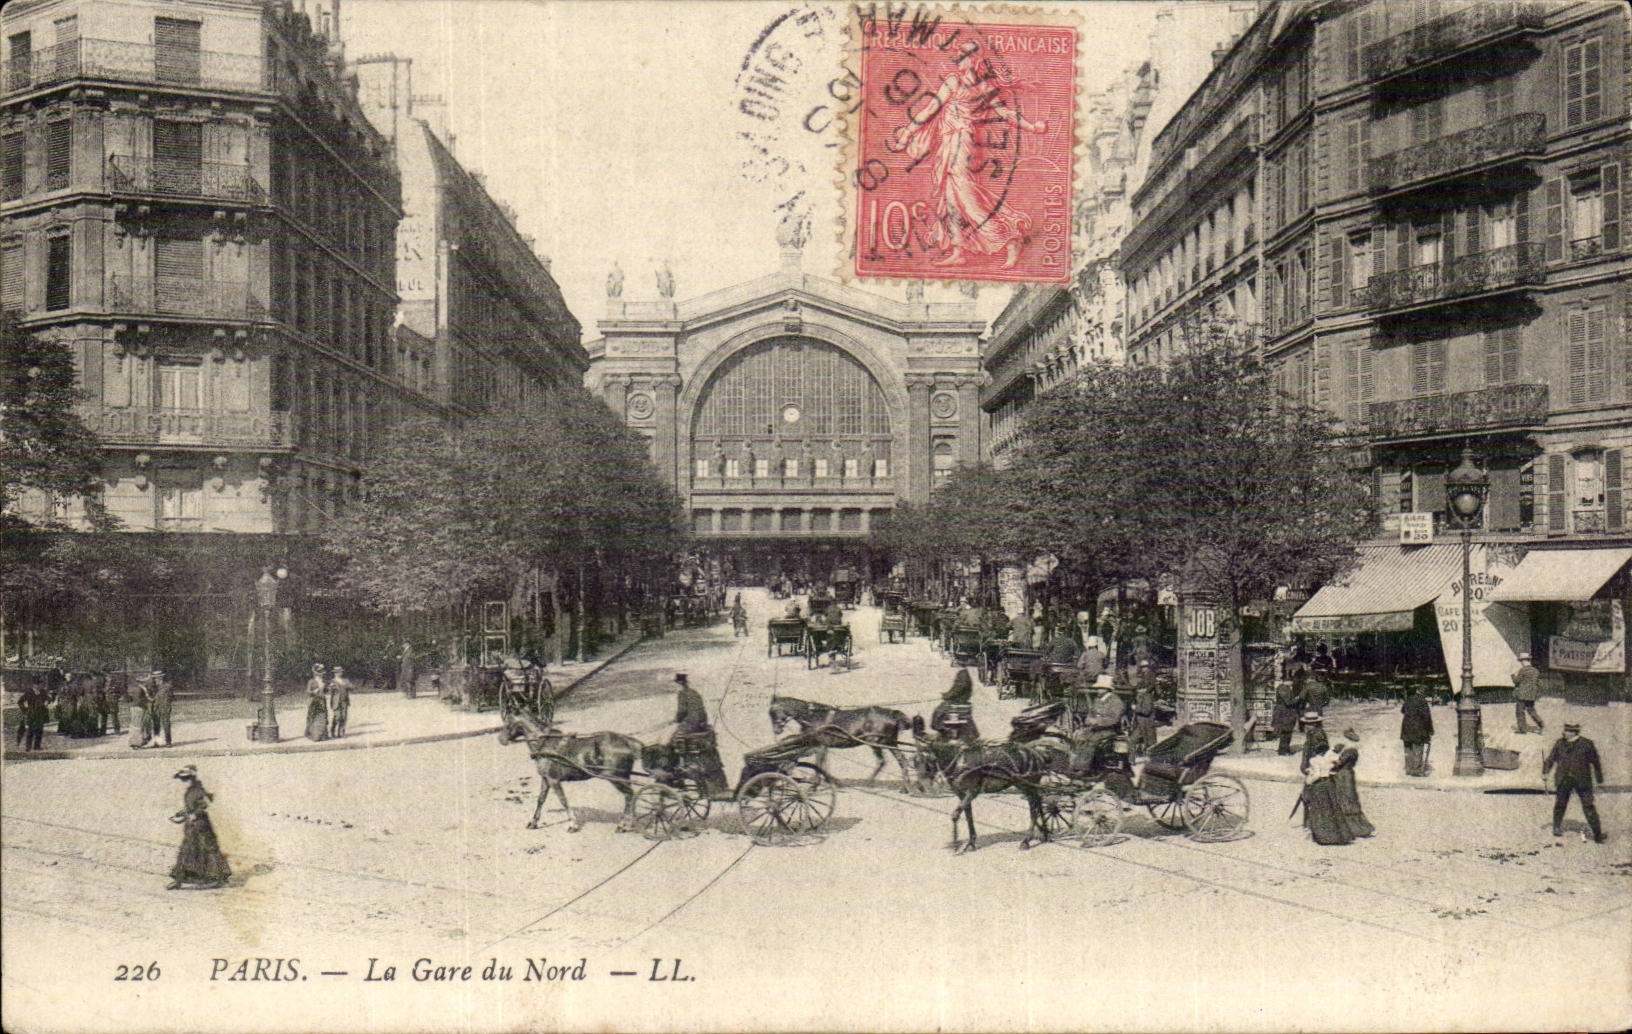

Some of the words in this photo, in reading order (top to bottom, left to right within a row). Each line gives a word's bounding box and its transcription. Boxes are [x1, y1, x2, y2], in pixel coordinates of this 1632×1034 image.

[1042, 184, 1063, 267] POSTES
[1451, 572, 1485, 597] BIRE
[1187, 609, 1215, 637] JOB
[1442, 618, 1458, 632] 20
